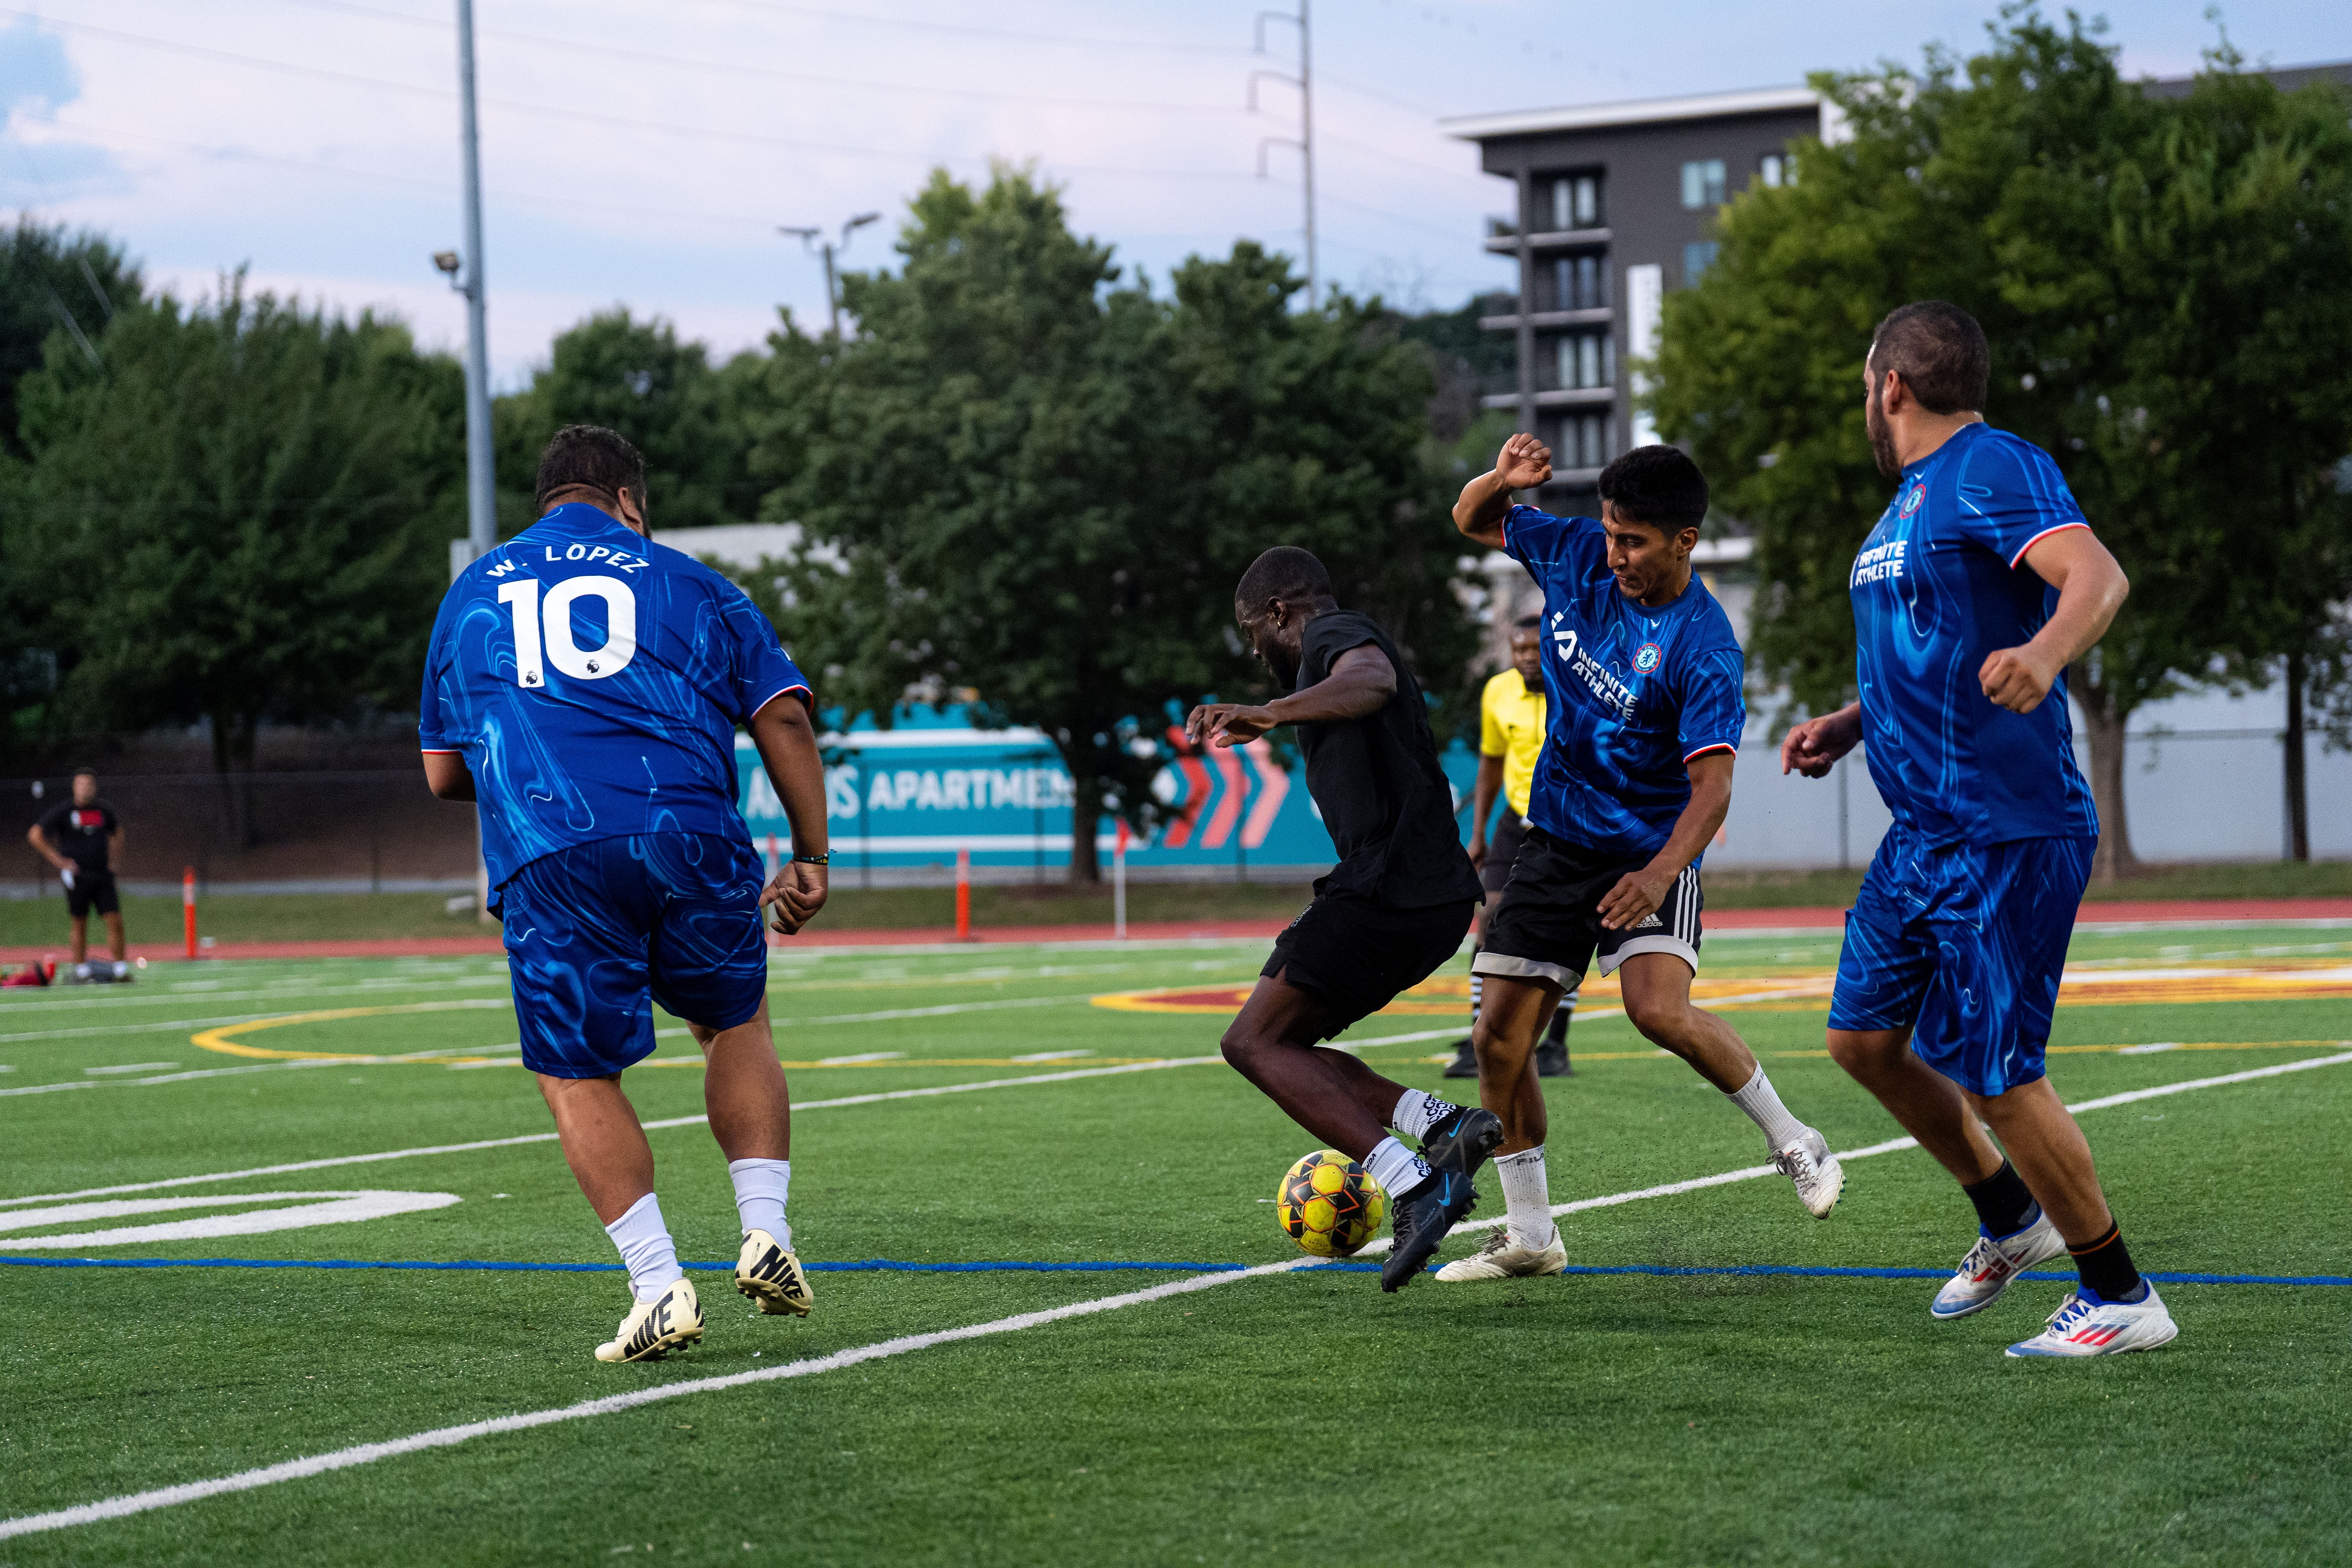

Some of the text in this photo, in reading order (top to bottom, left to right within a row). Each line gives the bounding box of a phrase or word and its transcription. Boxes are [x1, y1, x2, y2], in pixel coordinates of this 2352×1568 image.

[486, 544, 650, 577] W. LOPEZ
[1855, 559, 1904, 586] ATHLETE
[497, 575, 636, 688] 10
[1571, 661, 1634, 721] ATHLETE
[1578, 647, 1639, 707] INFINITE
[867, 768, 1078, 810] APARTMEN
[750, 1244, 805, 1300] NIKE
[624, 1290, 676, 1358] NIKE
